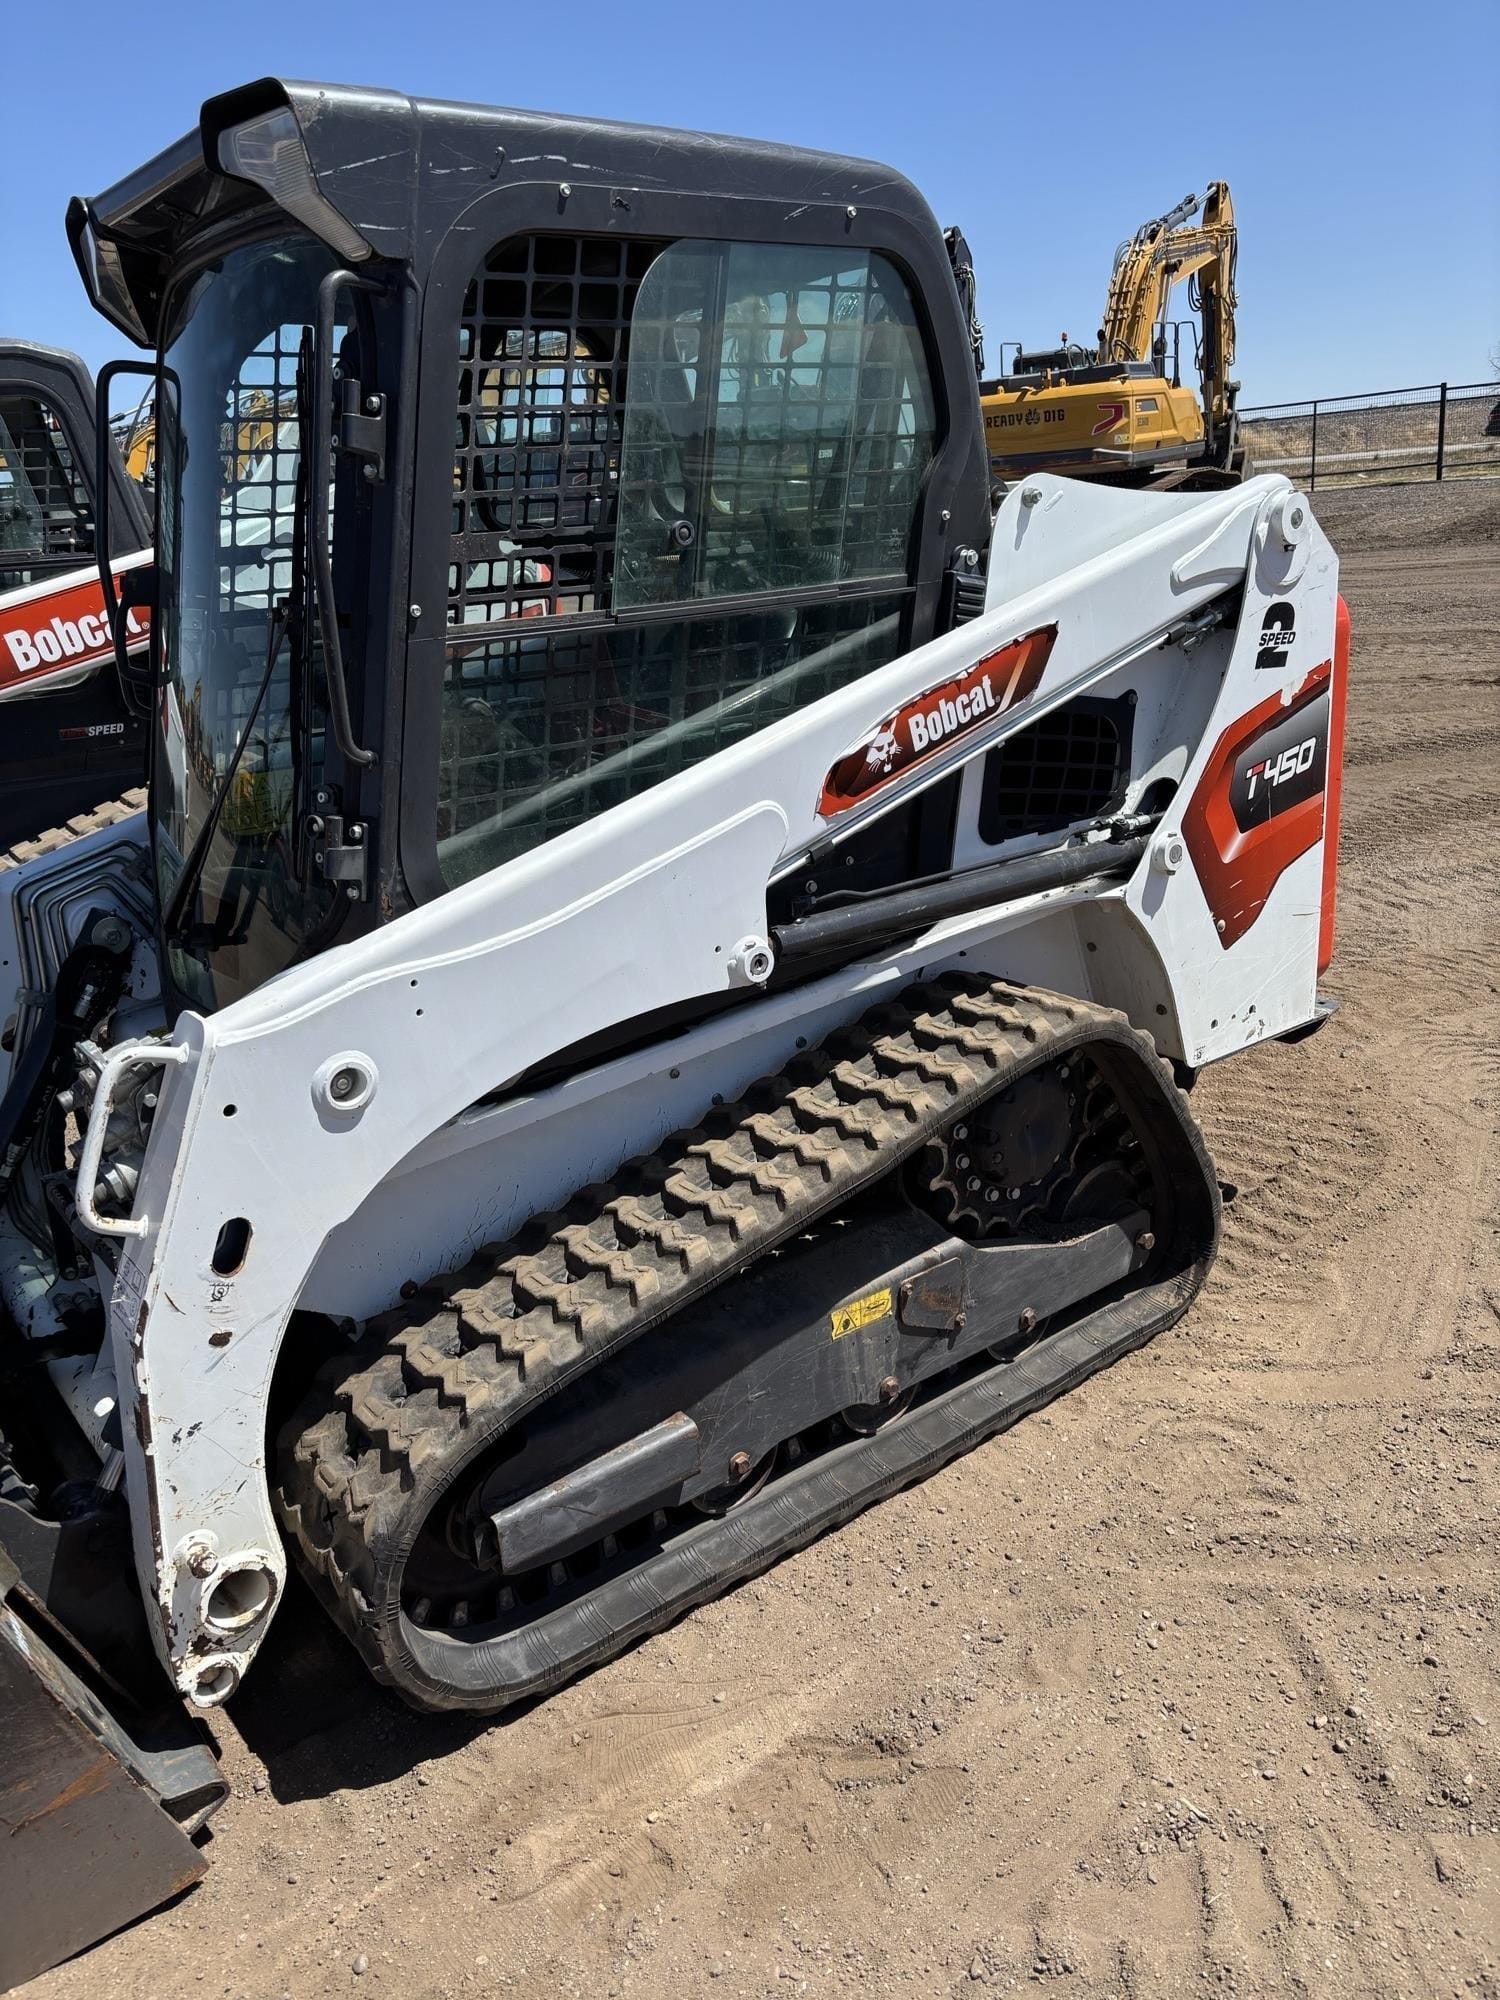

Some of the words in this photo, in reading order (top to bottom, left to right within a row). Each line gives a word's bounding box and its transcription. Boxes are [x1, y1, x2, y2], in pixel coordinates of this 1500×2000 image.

[986, 413, 1023, 428] READY
[1044, 409, 1065, 422] DIG
[1259, 632, 1296, 646] SPEED
[908, 674, 995, 752] Bobcat
[88, 723, 124, 737] SPEED
[1246, 737, 1316, 800] T450
